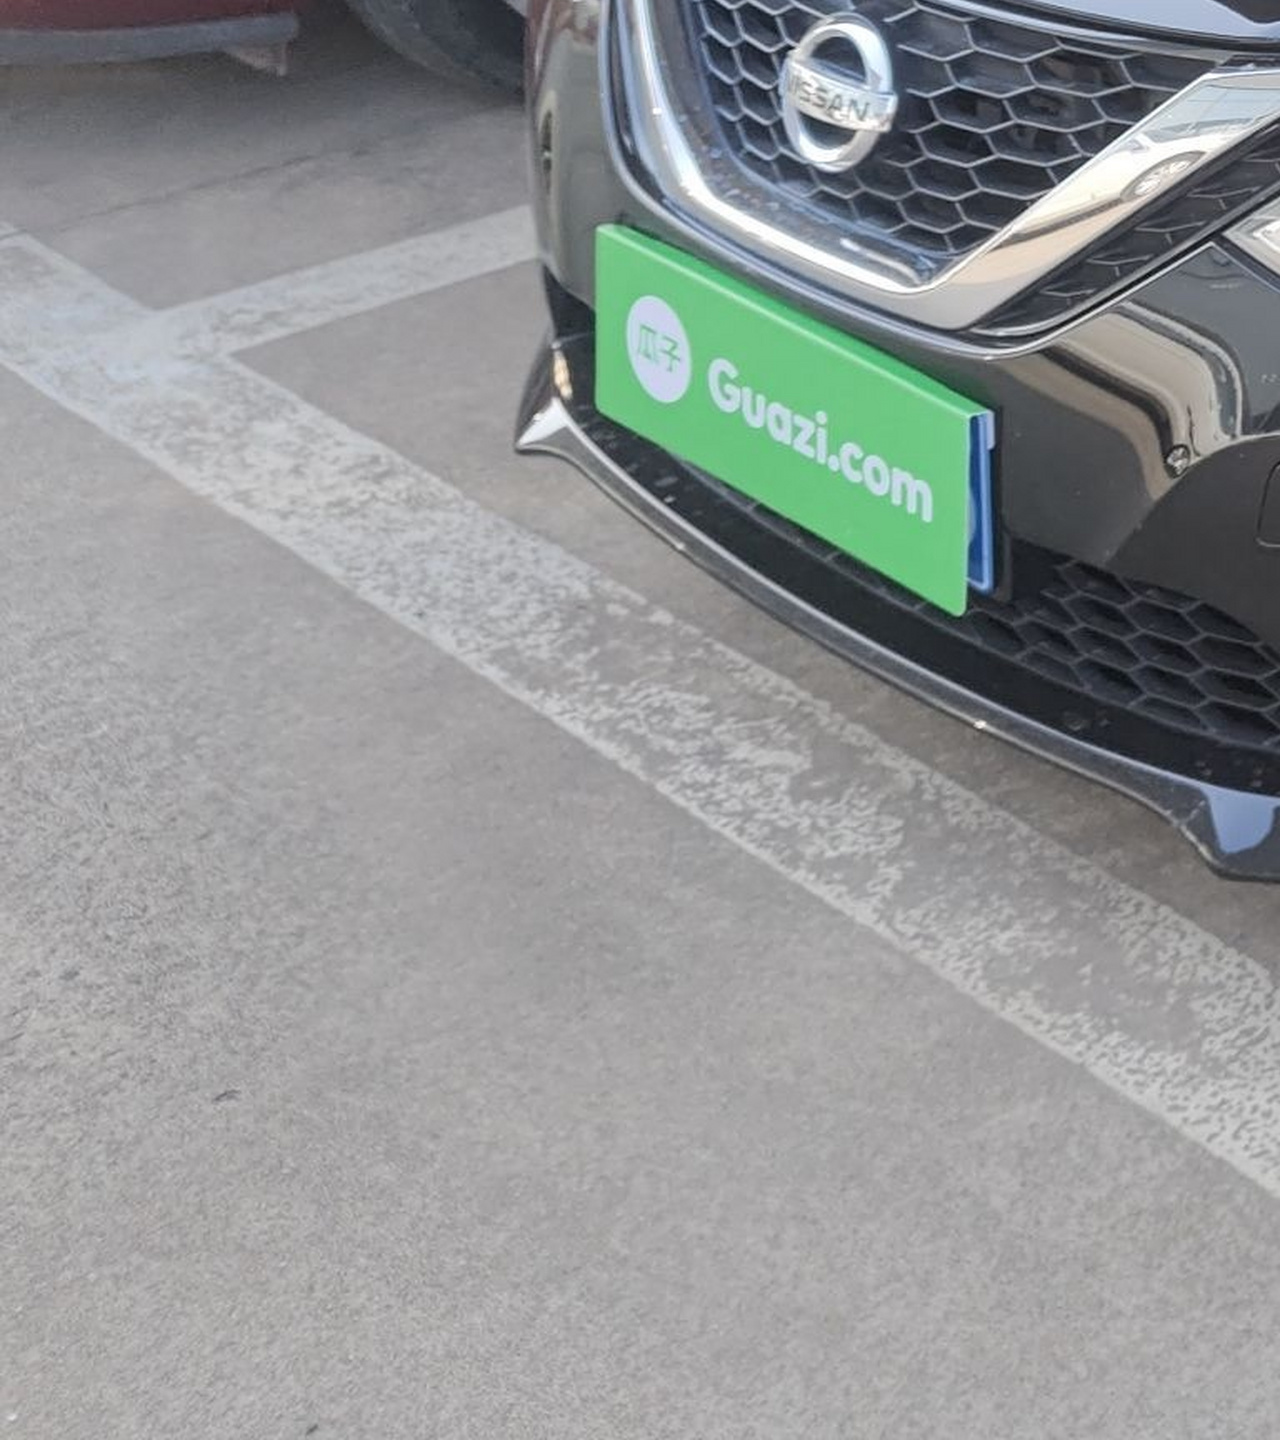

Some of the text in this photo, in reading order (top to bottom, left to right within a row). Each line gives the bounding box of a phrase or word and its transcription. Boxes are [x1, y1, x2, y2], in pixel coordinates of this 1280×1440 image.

[787, 73, 871, 122] NISSAN
[636, 323, 682, 374] 瓜子
[708, 357, 933, 523] Guazi.com
